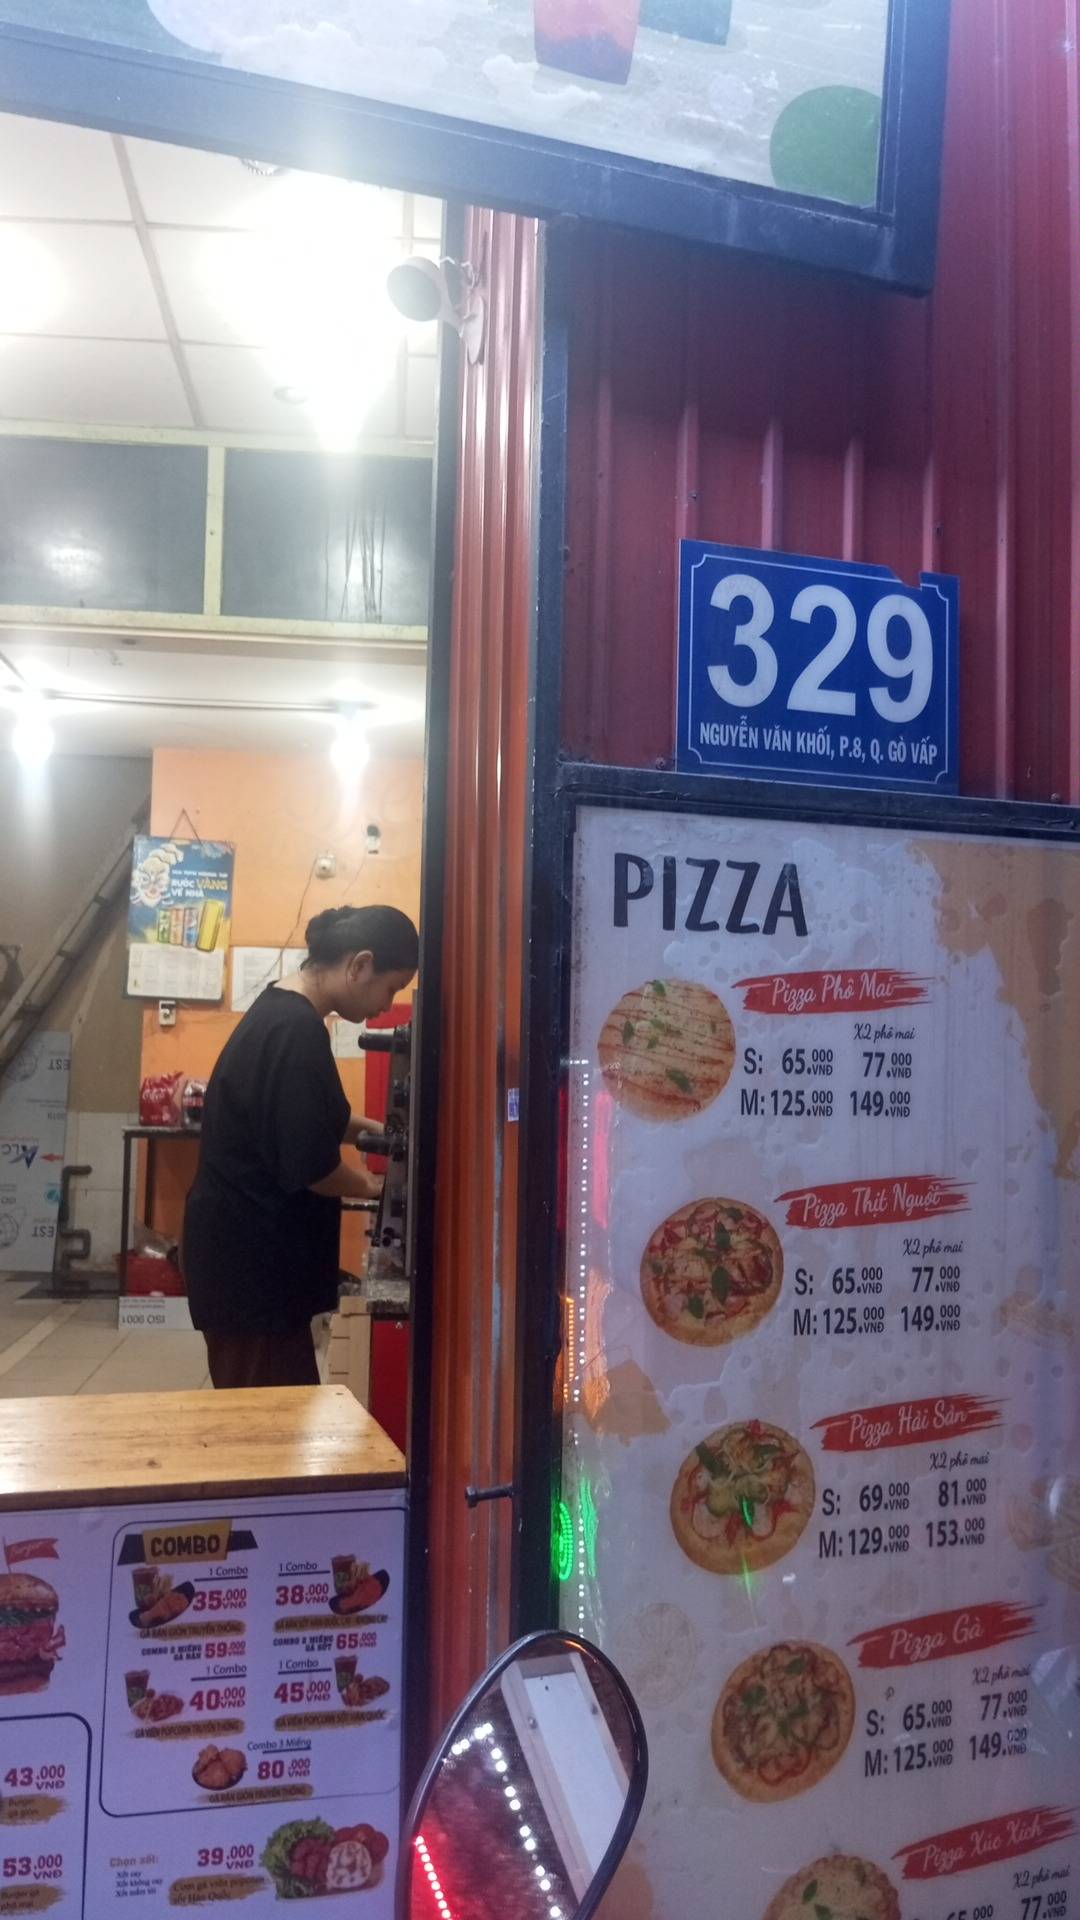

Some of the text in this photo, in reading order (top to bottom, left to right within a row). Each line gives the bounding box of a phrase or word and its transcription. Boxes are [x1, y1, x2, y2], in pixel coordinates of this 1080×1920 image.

[707, 574, 933, 723] 329
[700, 715, 937, 765] NGUYỄN VĂN KHỐI, P.8, Q. GÒ VẤP
[613, 853, 808, 937] PIZZA
[772, 972, 894, 1012] Pizza Phô Mai
[853, 1023, 915, 1044] X2 phô mai
[744, 1048, 912, 1079] S: 65.000 VNĐ 77.000 VNĐ
[741, 1089, 910, 1117] M: 125.000 VNĐ 149.000 VNĐ
[803, 1193, 848, 1227] Pizza
[852, 1187, 888, 1218] Thịt
[902, 1238, 964, 1258] X2 phô mai
[794, 1266, 961, 1295] S: 65.000 VNĐ 77.000 VNĐ
[793, 1305, 961, 1336] M: 125.000 VNĐ 149.000 VNĐ
[849, 1400, 967, 1448] Pizza Hải Sản
[929, 1451, 990, 1471] X2 phô mai
[822, 1478, 987, 1516] S: 69.000 VNĐ 81.000 VNĐ
[151, 1534, 221, 1557] COMBO
[819, 1518, 985, 1559] M: 129.000 VNĐ 153.000 VNĐ
[216, 1565, 248, 1576] Combo
[284, 1561, 318, 1571] Combo
[193, 1589, 247, 1611] 35.000
[276, 1584, 329, 1605] 38.000
[889, 1614, 985, 1661] Pizza Gà
[212, 1663, 247, 1674] Combo
[285, 1658, 319, 1669] Combo
[190, 1687, 245, 1711] 40.000
[275, 1681, 331, 1704] 45.000
[866, 1689, 1028, 1737] S: 65.000 VNĐ 77.000 VNĐ
[247, 1740, 277, 1751] Combo
[4, 1764, 65, 1787] 43.000
[864, 1750, 888, 1778] M:
[3, 1854, 62, 1877] 53.000
[198, 1845, 254, 1867] 39.000
[922, 1845, 965, 1872] Pizza
